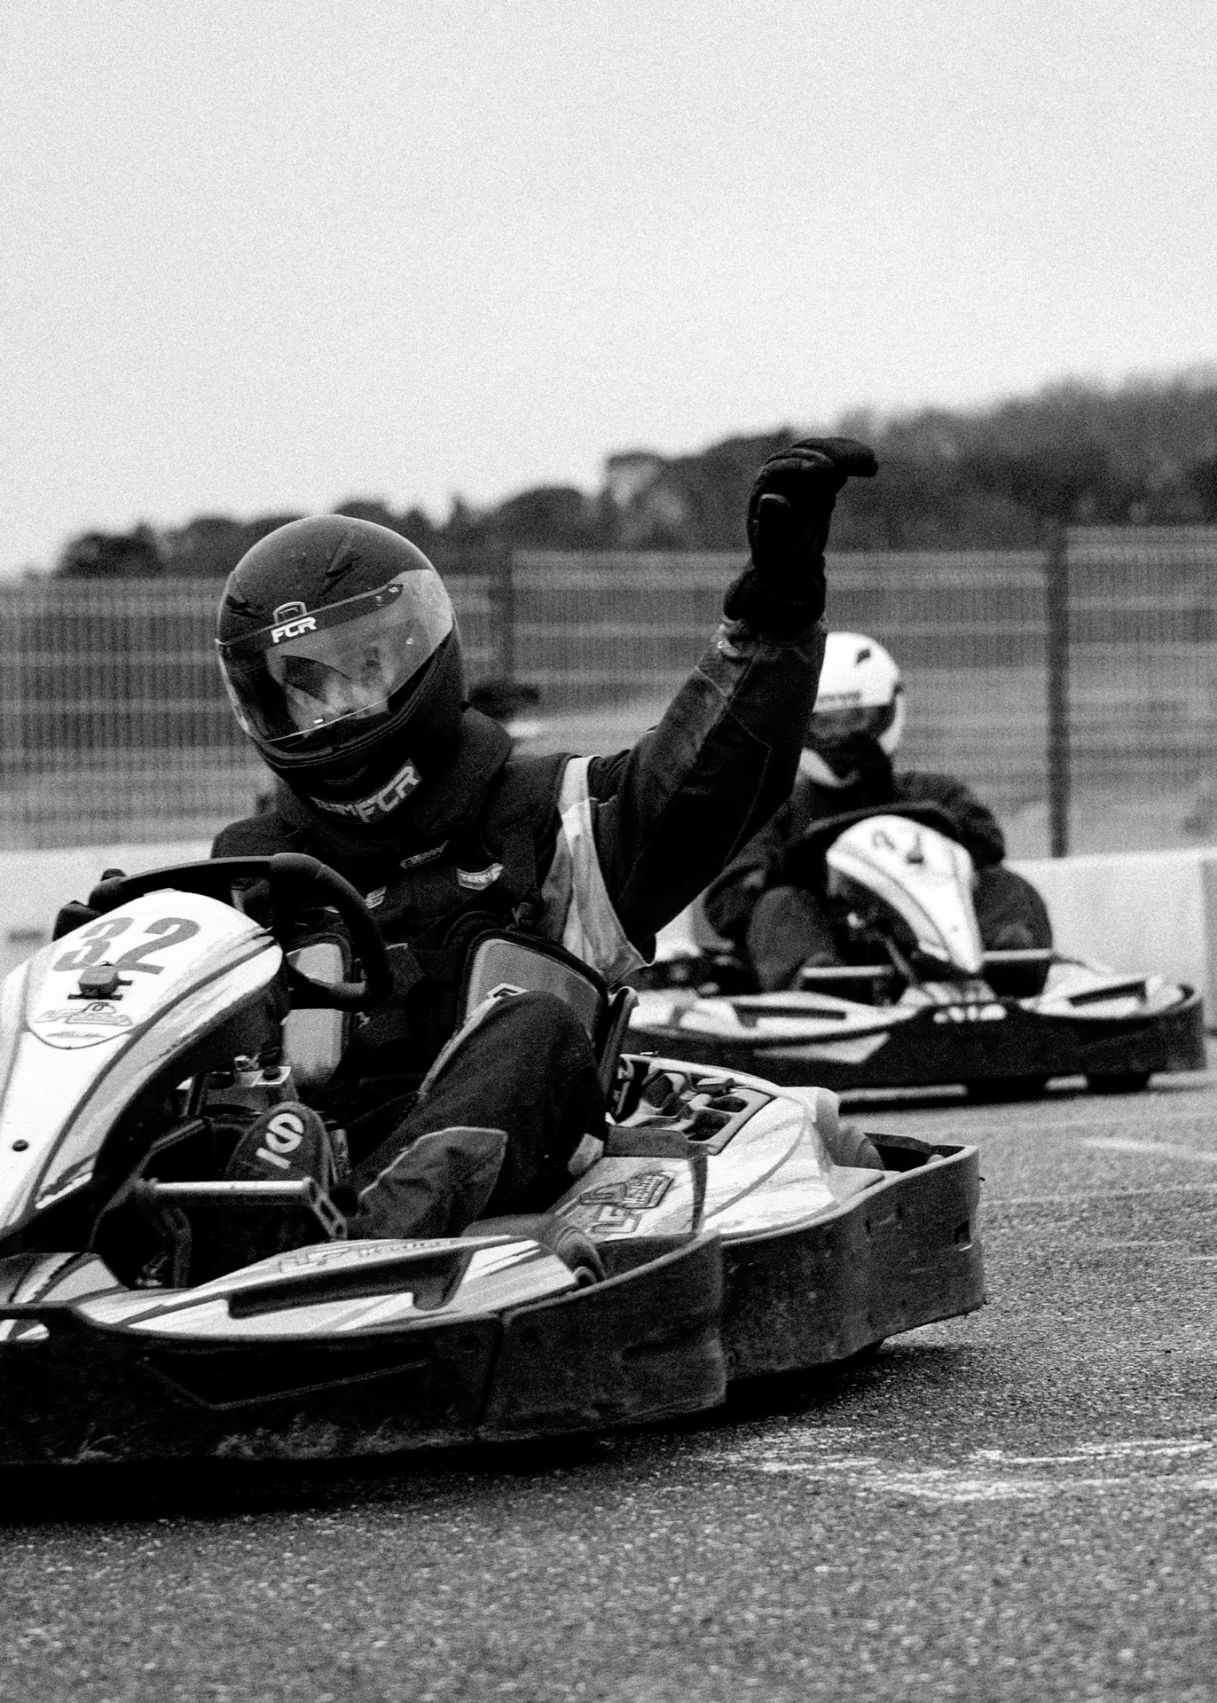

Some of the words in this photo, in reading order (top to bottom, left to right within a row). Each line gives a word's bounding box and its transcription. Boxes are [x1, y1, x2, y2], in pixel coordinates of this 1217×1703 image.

[270, 616, 317, 644] FCR
[355, 765, 420, 823] FCR
[52, 916, 201, 975] 32
